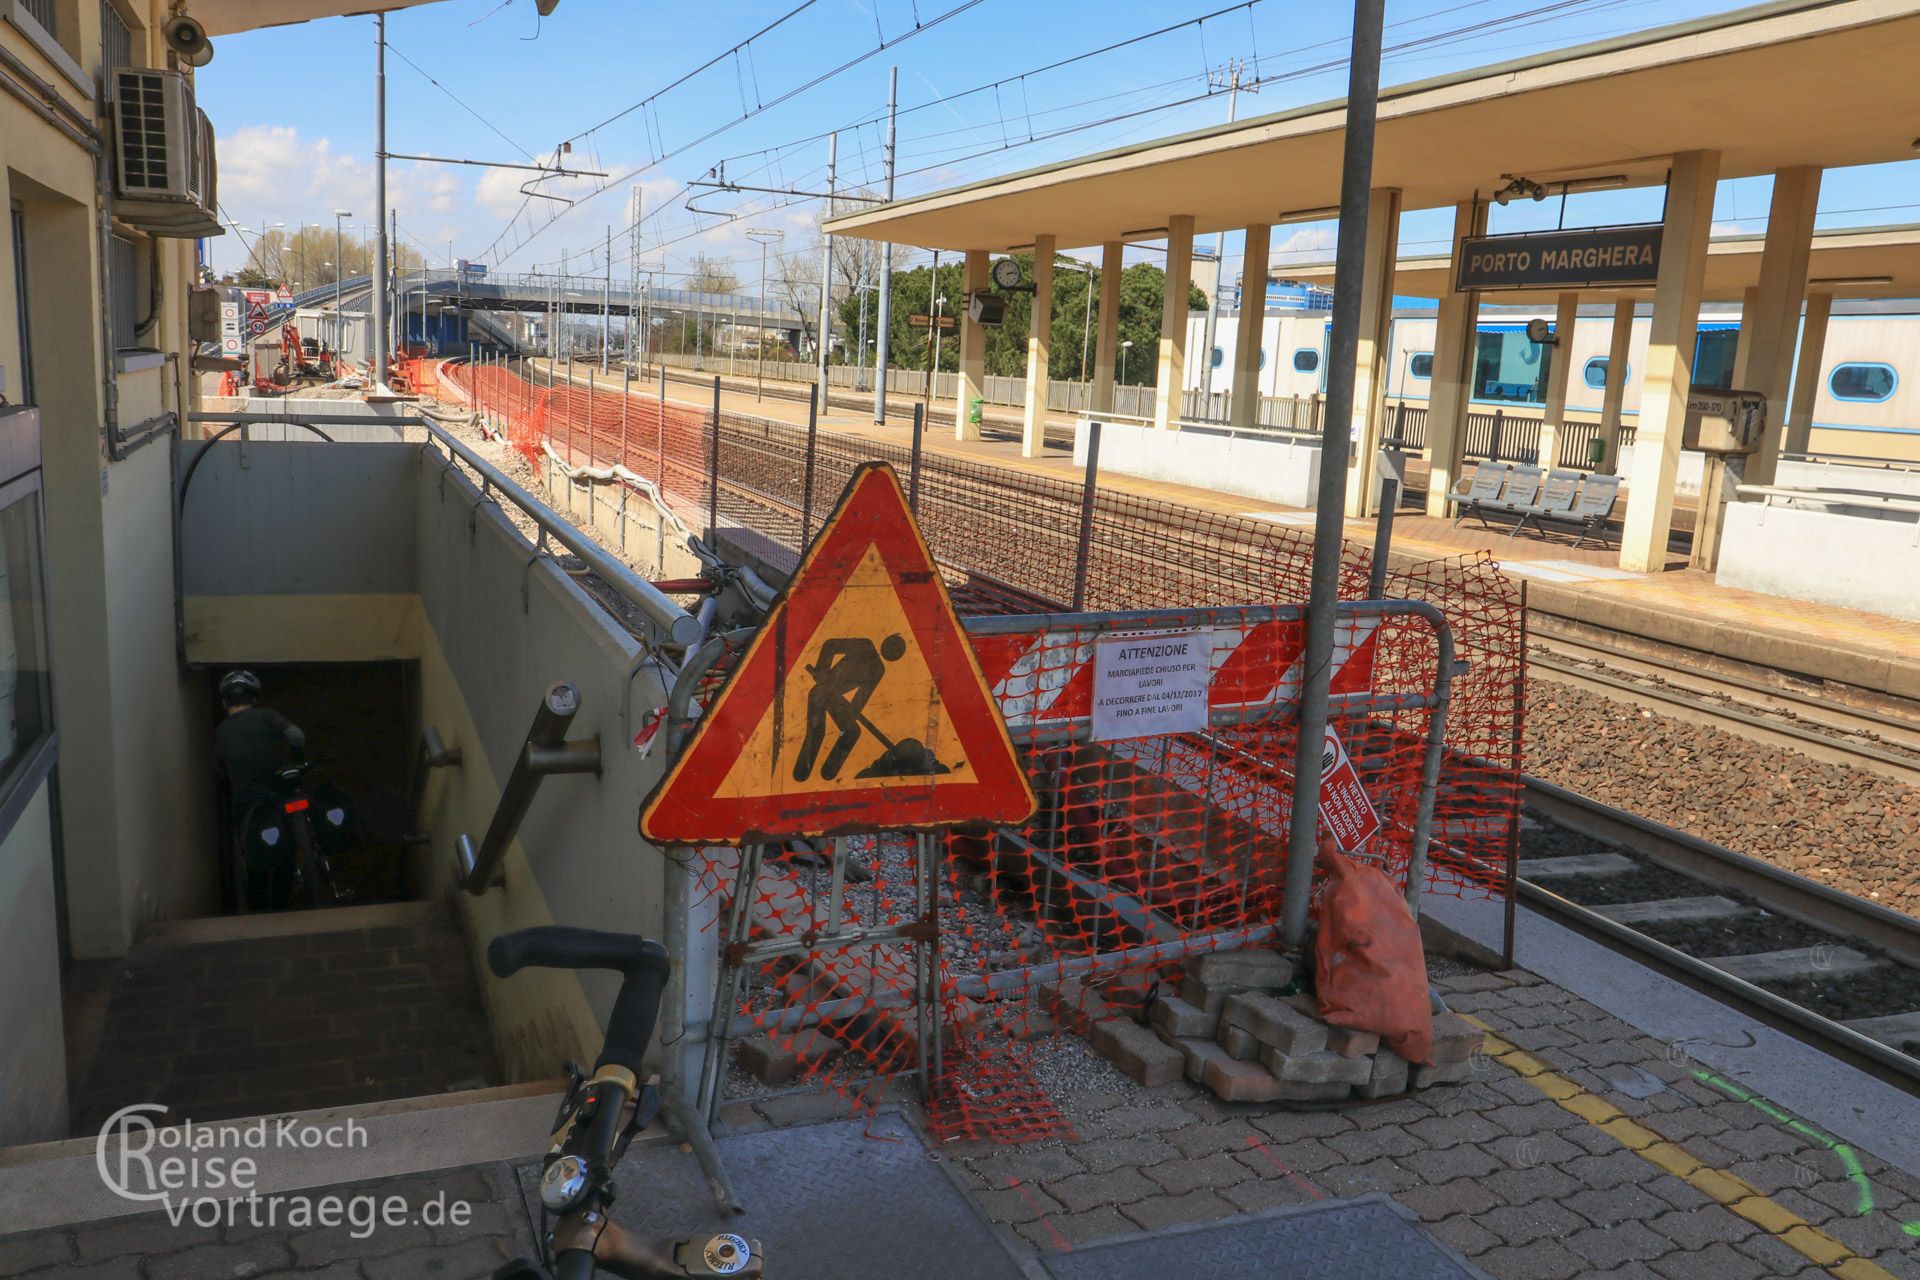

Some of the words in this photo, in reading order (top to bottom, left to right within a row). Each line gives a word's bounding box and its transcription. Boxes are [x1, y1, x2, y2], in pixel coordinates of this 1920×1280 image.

[1471, 252, 1530, 273] PORTO
[1540, 244, 1654, 270] MARGHERA
[254, 323, 263, 331] 50
[1118, 643, 1189, 661] ATTENZIONE
[1107, 667, 1156, 678] MARCIAPIEDE
[1156, 664, 1181, 674] CHIUSO
[1182, 663, 1196, 672] PER
[1138, 679, 1163, 688] LAVORI
[1098, 698, 1104, 706] A
[1105, 695, 1145, 706] DECORRERE
[1146, 694, 1160, 702] DAL
[1161, 690, 1202, 701] 04/12/2017
[1116, 708, 1134, 718] FINO
[1134, 708, 1140, 716] A
[1141, 706, 1156, 715] FINE
[1157, 704, 1183, 713] LAVORI
[1336, 781, 1364, 828] L'INGRESSO
[1348, 781, 1368, 815] VIETATO
[1323, 800, 1331, 811] AI
[1328, 809, 1347, 839] LAVORI
[1325, 782, 1333, 793] AI
[1330, 792, 1343, 810] NON
[1339, 810, 1361, 843] ADDETTI
[718, 1234, 747, 1256] RITCHEY
